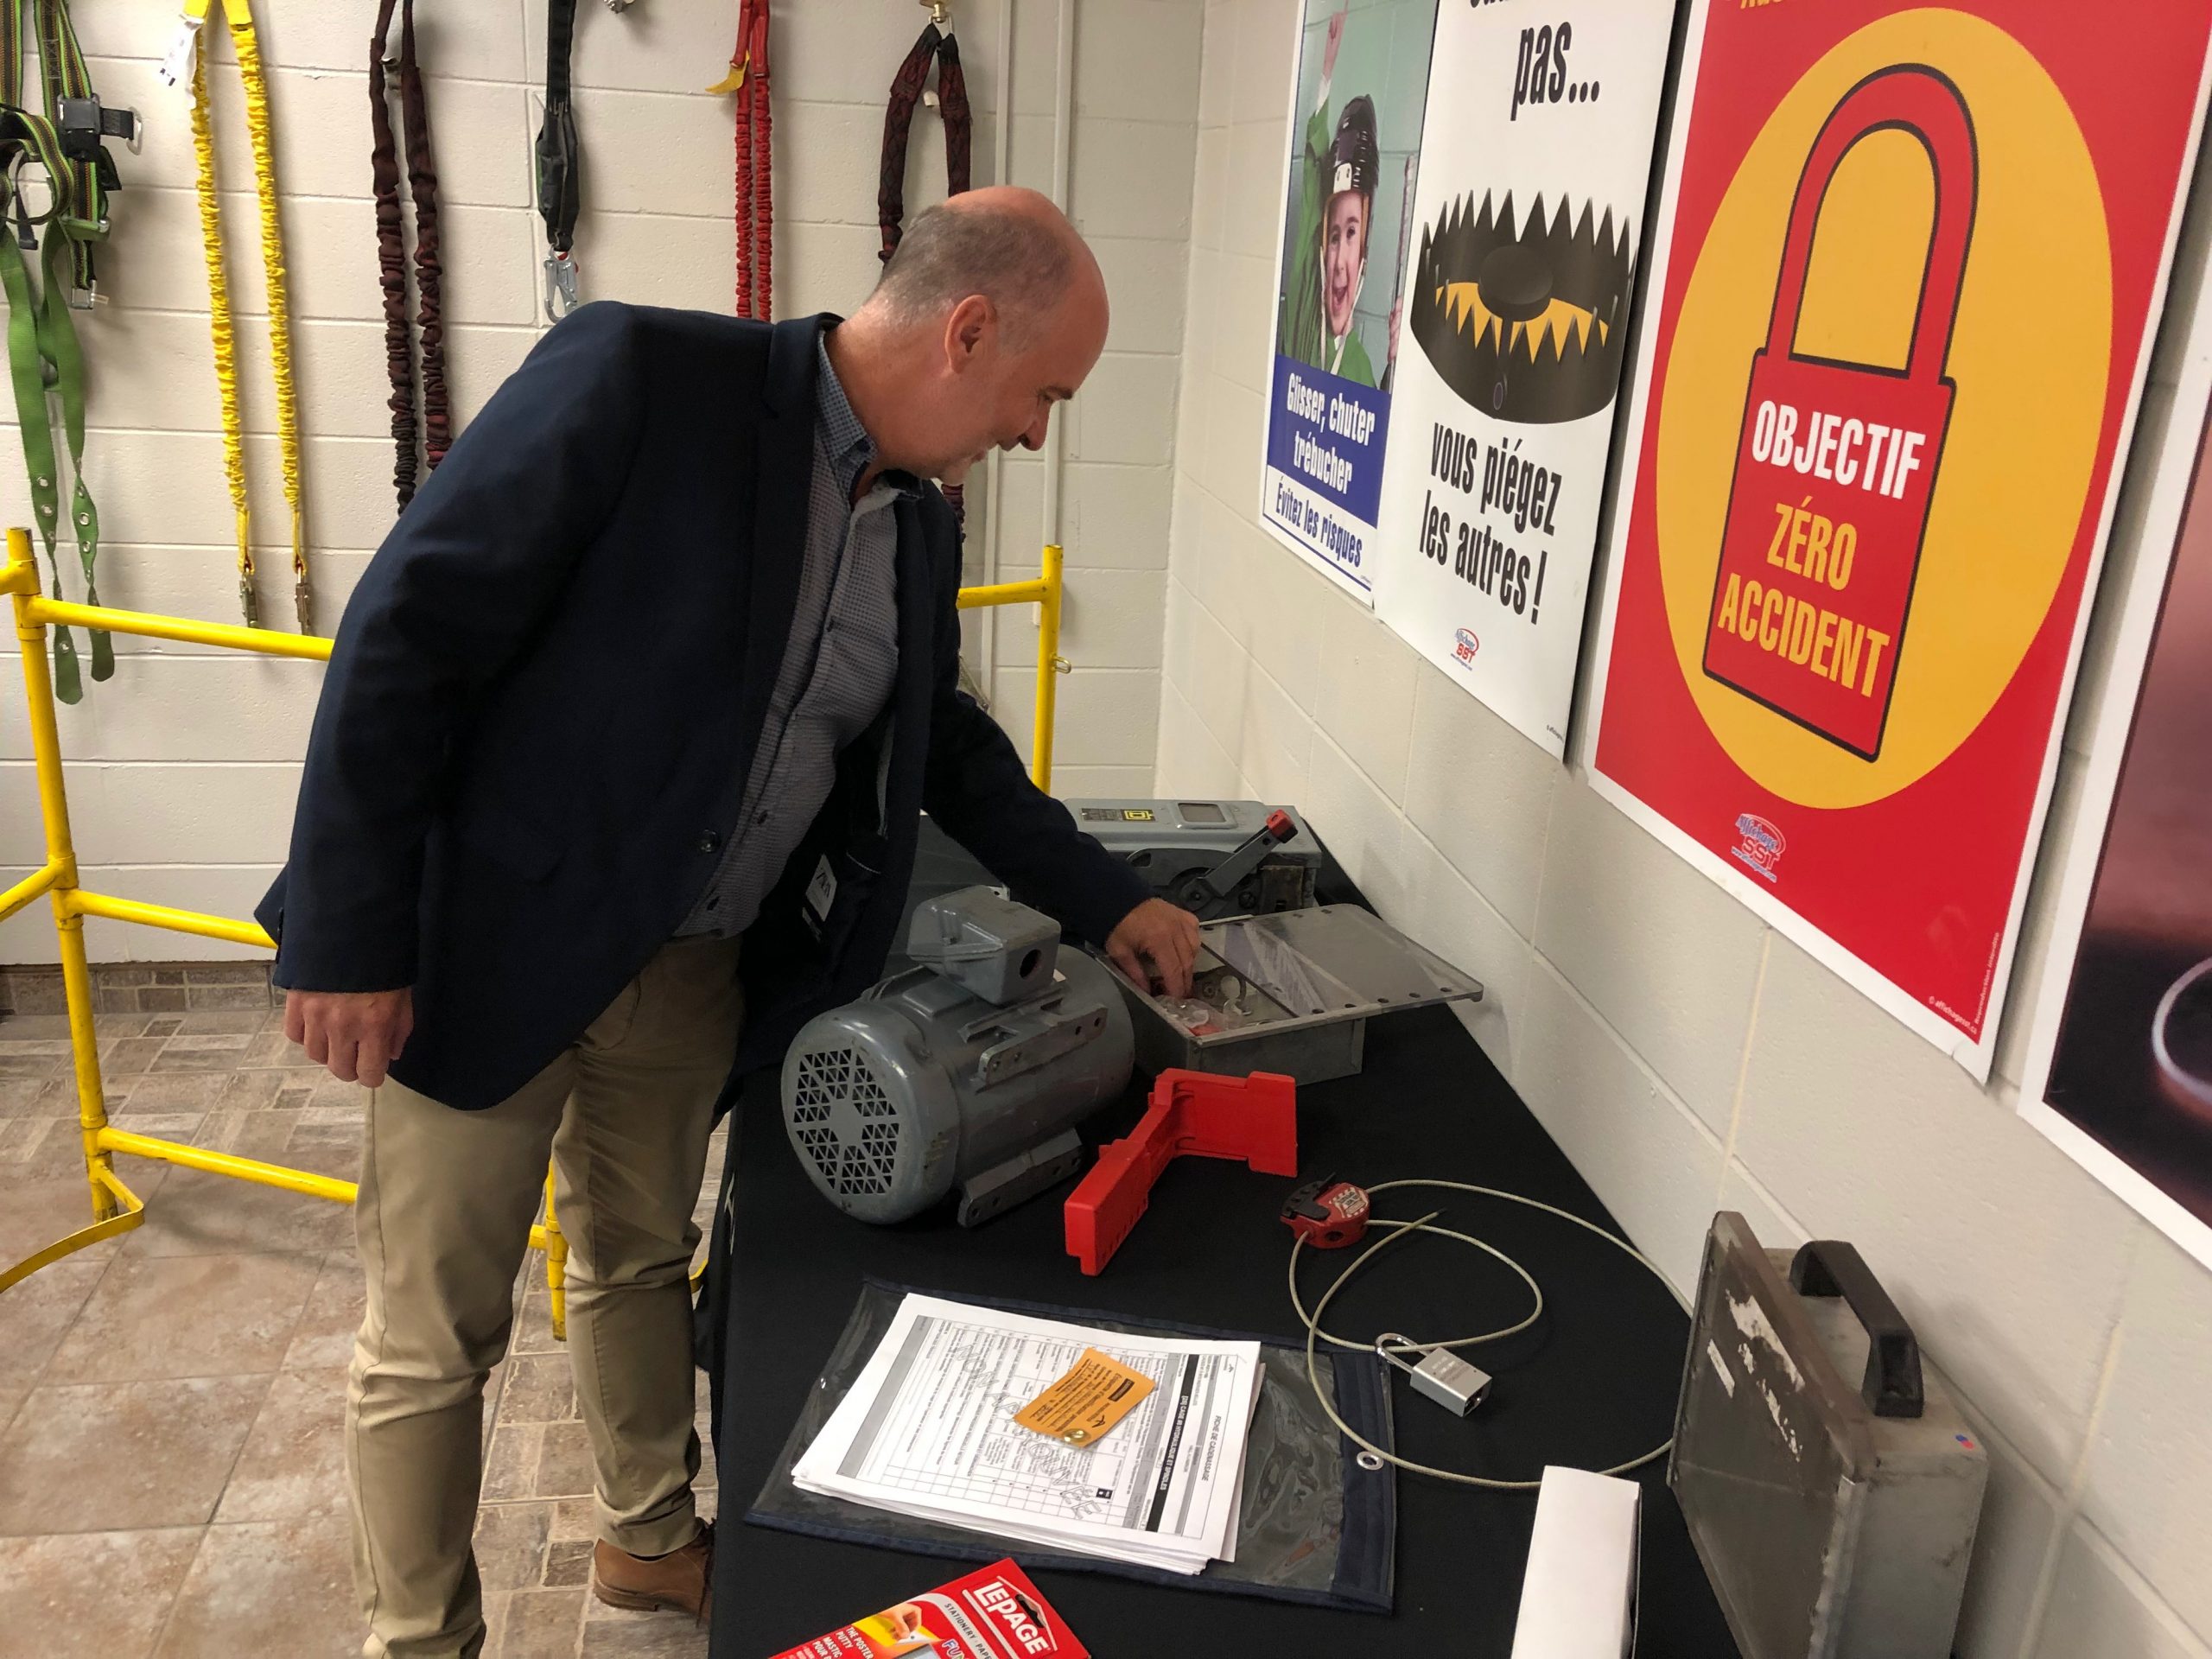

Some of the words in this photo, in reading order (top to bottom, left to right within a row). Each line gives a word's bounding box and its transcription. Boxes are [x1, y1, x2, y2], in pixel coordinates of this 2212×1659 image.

[1510, 22, 1599, 121] pas...
[1287, 372, 1326, 433] Glisser,
[1329, 392, 1376, 446] chuter
[1294, 430, 1353, 494] trébucher
[1431, 423, 1478, 494] vous
[1480, 437, 1562, 537] piégez
[1752, 400, 1926, 499] OBJECTIF
[1275, 476, 1303, 527] Évitez
[1303, 499, 1319, 538] les
[1320, 513, 1363, 568] risques
[1420, 489, 1450, 566] les
[1767, 495, 1857, 591] ZÉRO
[1456, 642, 1475, 663] SST
[1718, 572, 1891, 697] ACCIDENT
[1735, 815, 1778, 852] Affichage
[1742, 834, 1781, 871] SST
[812, 1641, 827, 1659] POUR
[823, 1636, 843, 1658] MASTIC
[835, 1630, 854, 1649] PUTTY
[846, 1626, 858, 1639] THE
[854, 1637, 874, 1659] POSTER
[944, 1603, 975, 1639] STATIONERY
[973, 1581, 1049, 1655] LEPAGE
